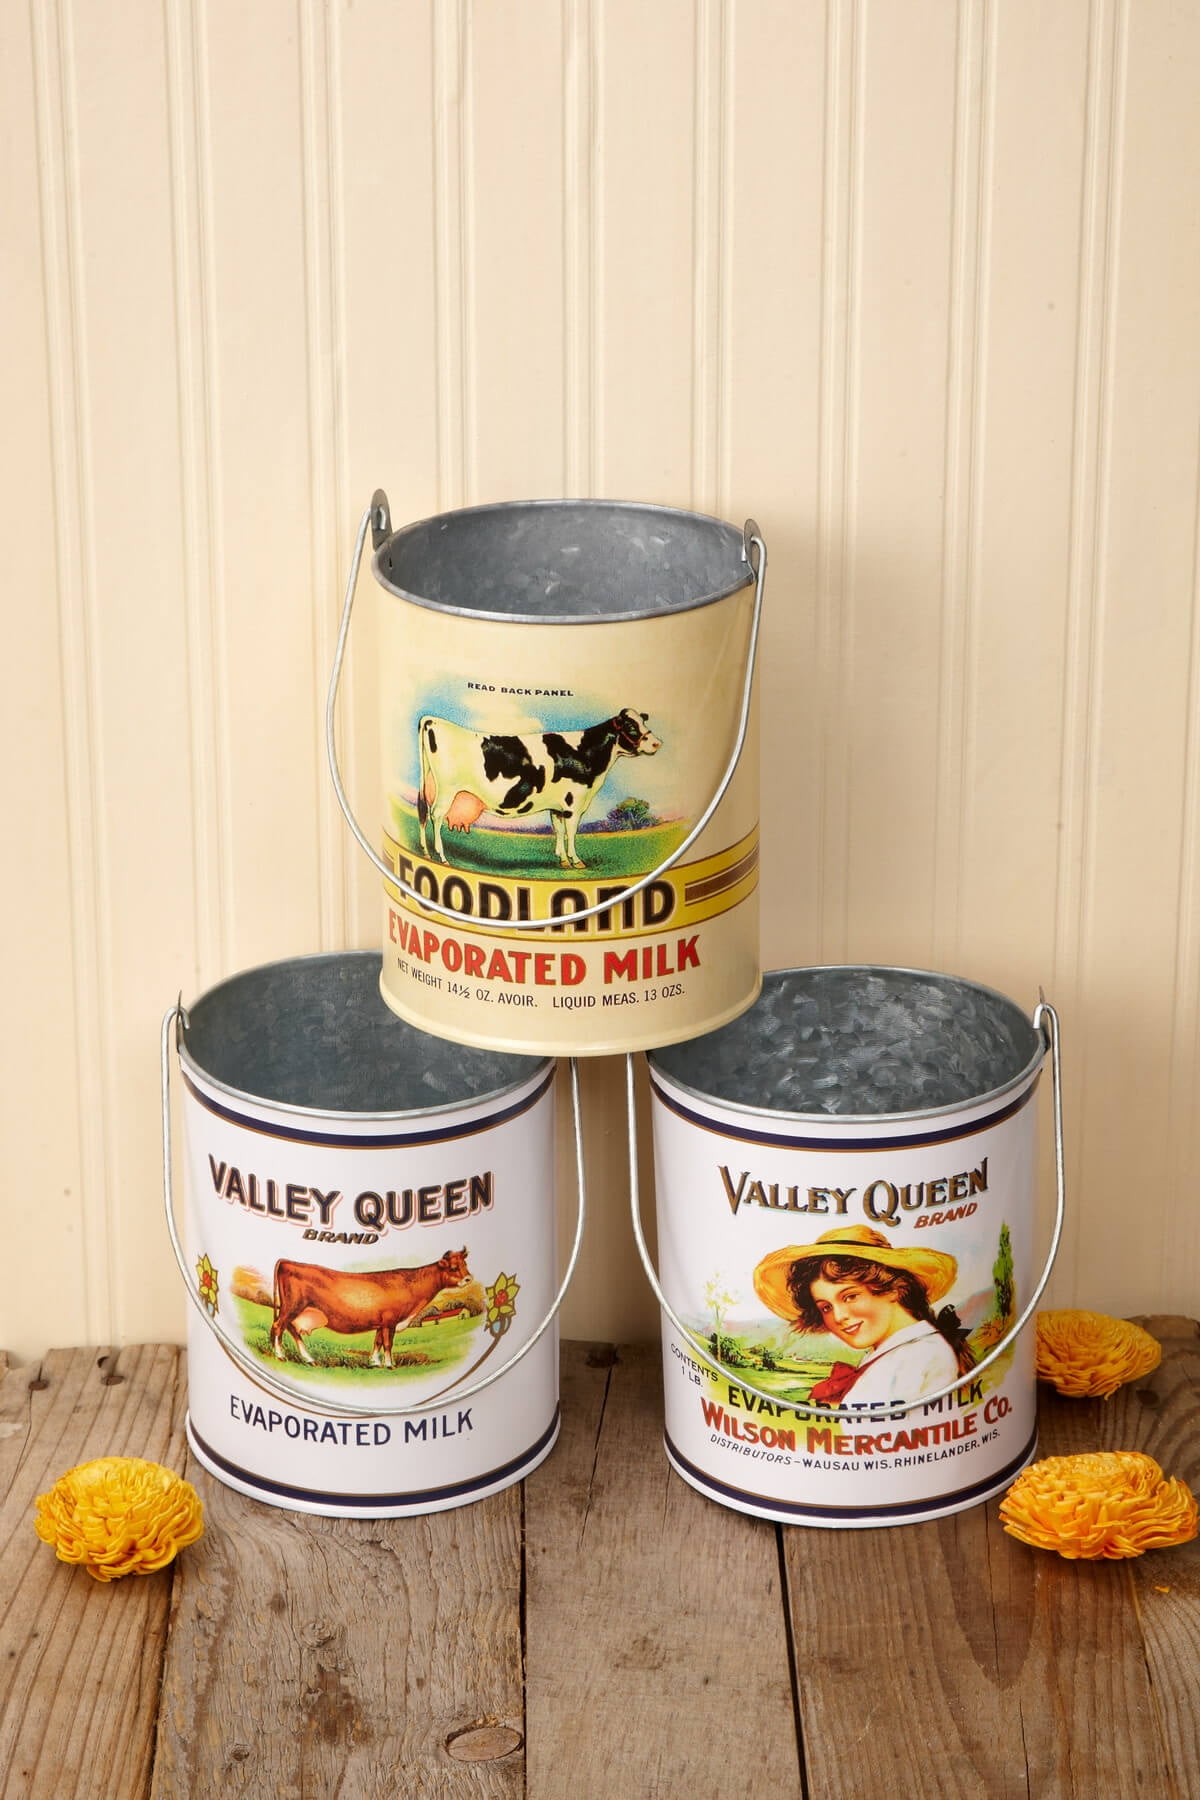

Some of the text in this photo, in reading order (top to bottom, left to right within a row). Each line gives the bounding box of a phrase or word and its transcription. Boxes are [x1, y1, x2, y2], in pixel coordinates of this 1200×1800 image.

[468, 682, 495, 692] READ
[501, 687, 531, 695] BACK
[398, 853, 676, 932] FOODLAND
[388, 908, 701, 986] EVAPORATED MILK
[397, 958, 409, 975] NET
[411, 966, 442, 990] WEIGHT
[476, 989, 494, 1002] OZ.
[498, 993, 538, 1008] AVOIR.
[553, 996, 596, 1010] LIQUID
[602, 992, 639, 1007] MEAS.
[644, 989, 657, 1002] 13
[662, 983, 685, 999] OZS.
[208, 1153, 494, 1234] VALLEY QUEEN
[718, 1157, 988, 1228] VALLEY QUEEN
[914, 1202, 978, 1229] BRAND
[302, 1229, 379, 1245] BRAND
[670, 1343, 718, 1382] CONTENTS
[681, 1366, 703, 1387] 1 LB.
[230, 1394, 474, 1446] EVAPORATED MILK
[923, 1379, 983, 1416] MILK
[701, 1396, 796, 1453] WILSON
[806, 1413, 978, 1456] MERCANTILE
[864, 1459, 892, 1470] WIS.
[981, 1429, 1001, 1445] WIS.
